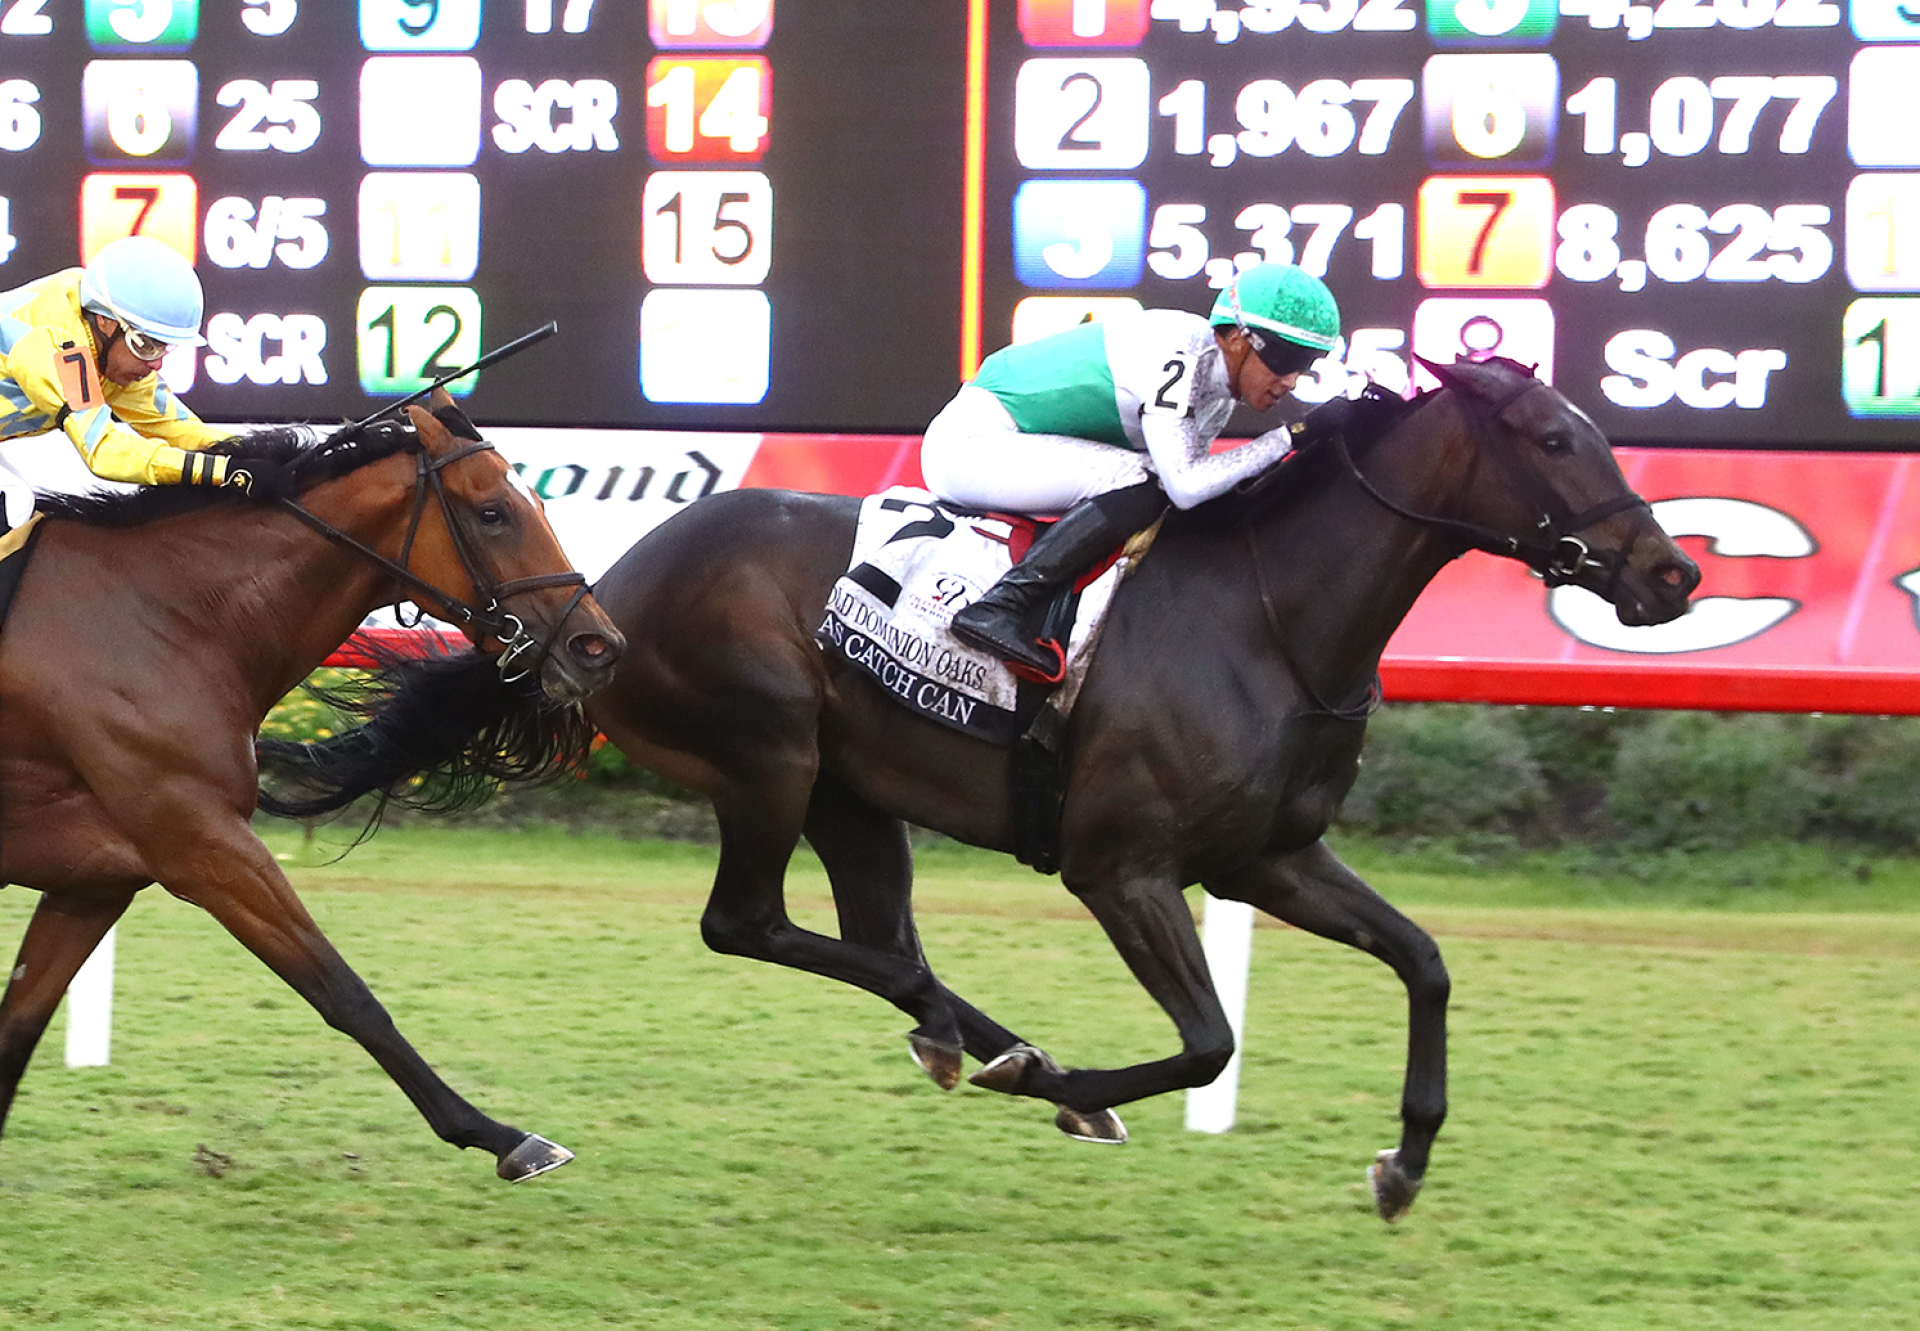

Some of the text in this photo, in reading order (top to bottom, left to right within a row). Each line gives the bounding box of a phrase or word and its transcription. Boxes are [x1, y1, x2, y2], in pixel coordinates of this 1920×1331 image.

[107, 74, 322, 156] 6 25
[491, 79, 620, 153] SCR
[647, 66, 768, 152] 14
[1057, 72, 1415, 167] 2 1,967
[1451, 74, 1838, 166] 6 1,077
[204, 196, 329, 269] 6/5
[378, 200, 453, 266] 11
[656, 191, 754, 265] 15
[1042, 192, 1405, 288] 3 5,371
[1457, 190, 1834, 292] 7 8,625
[63, 352, 91, 403] 7
[205, 313, 329, 385] SCR
[368, 303, 466, 379] 12
[1600, 329, 1788, 409] Scr
[1154, 359, 1186, 410] 2
[511, 450, 723, 503] ond
[817, 612, 977, 726] AS CATCH CAN
[854, 602, 936, 669] DOMINION
[935, 651, 987, 690] OAKS
